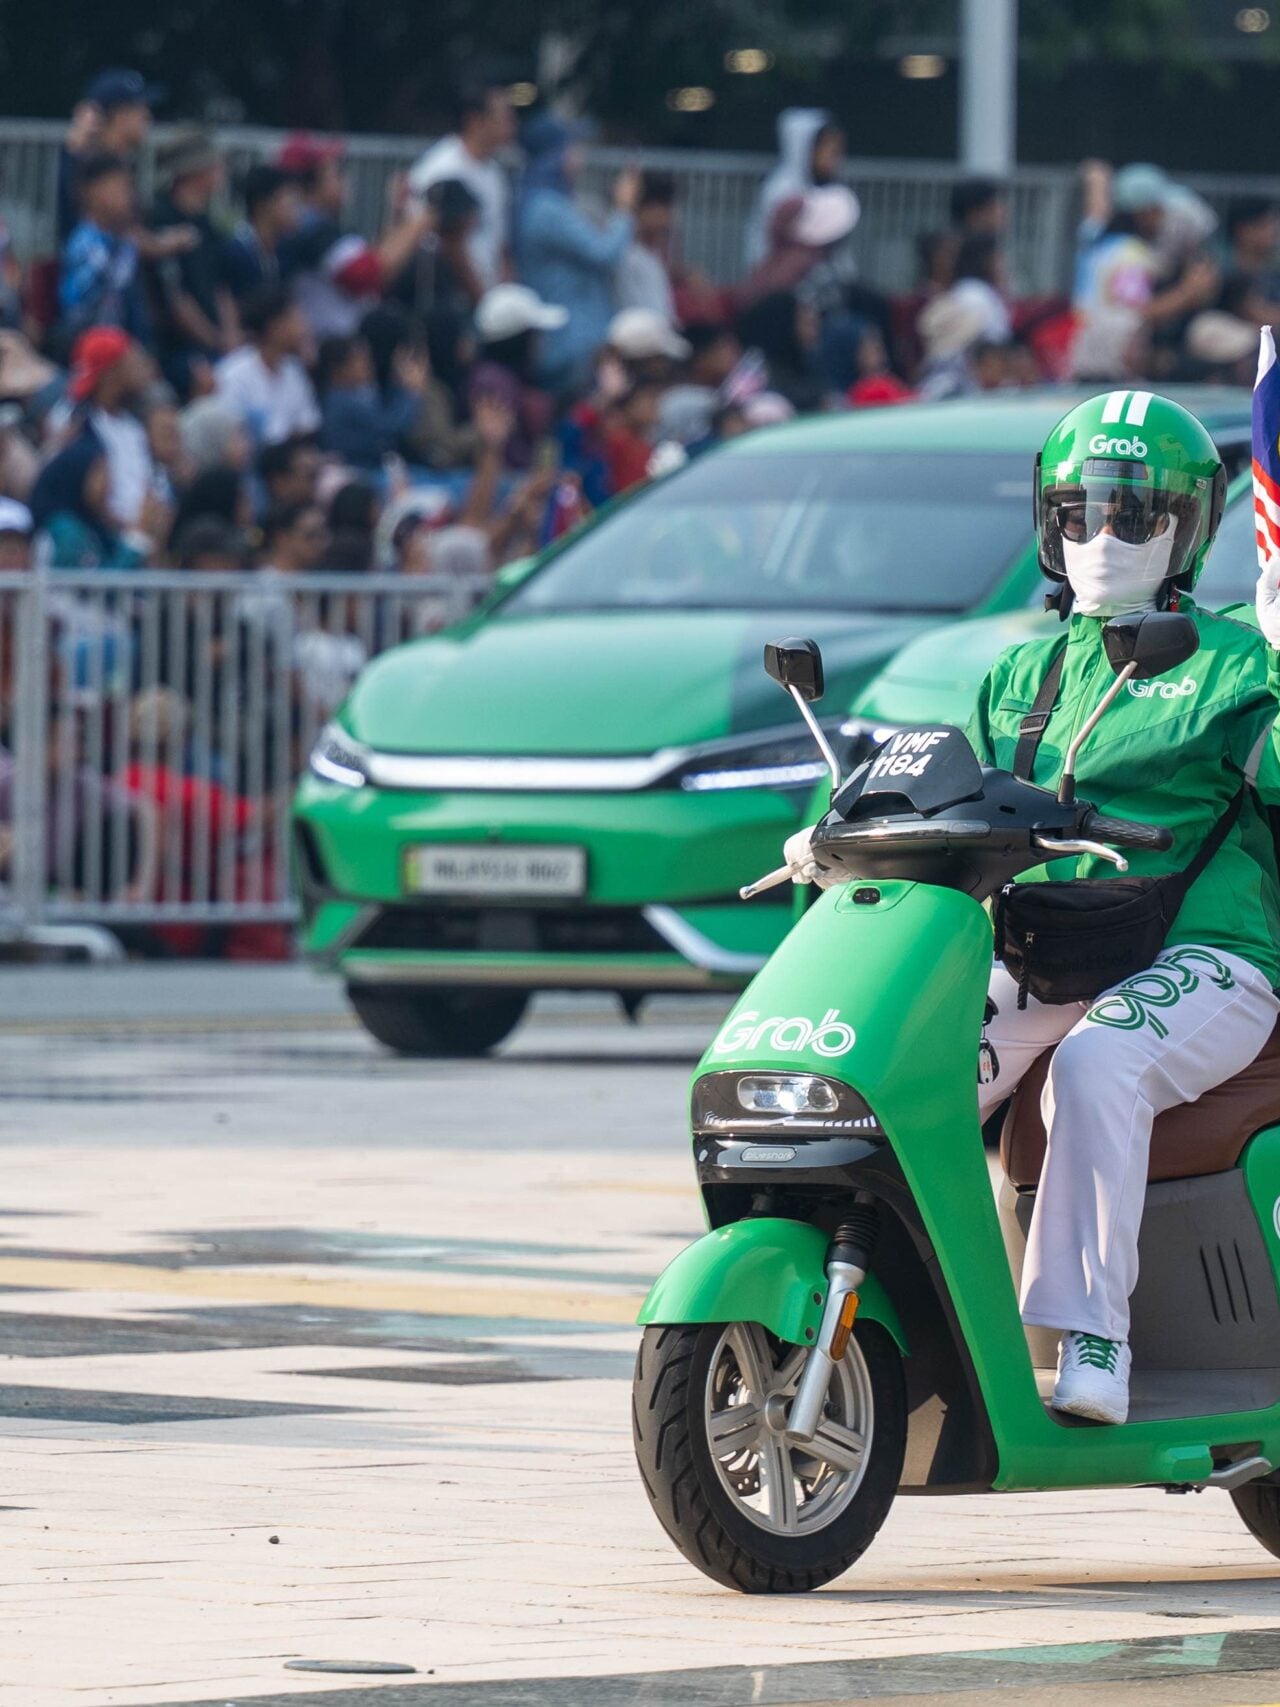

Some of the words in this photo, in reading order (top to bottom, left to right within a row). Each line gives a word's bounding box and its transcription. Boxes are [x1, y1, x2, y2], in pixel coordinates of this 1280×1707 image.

[1088, 434, 1148, 458] Grab
[1127, 675, 1197, 699] Grab
[890, 731, 950, 755] VMF
[869, 754, 933, 779] 1184
[714, 1008, 857, 1058] Grab
[745, 1151, 793, 1160] blueshark
